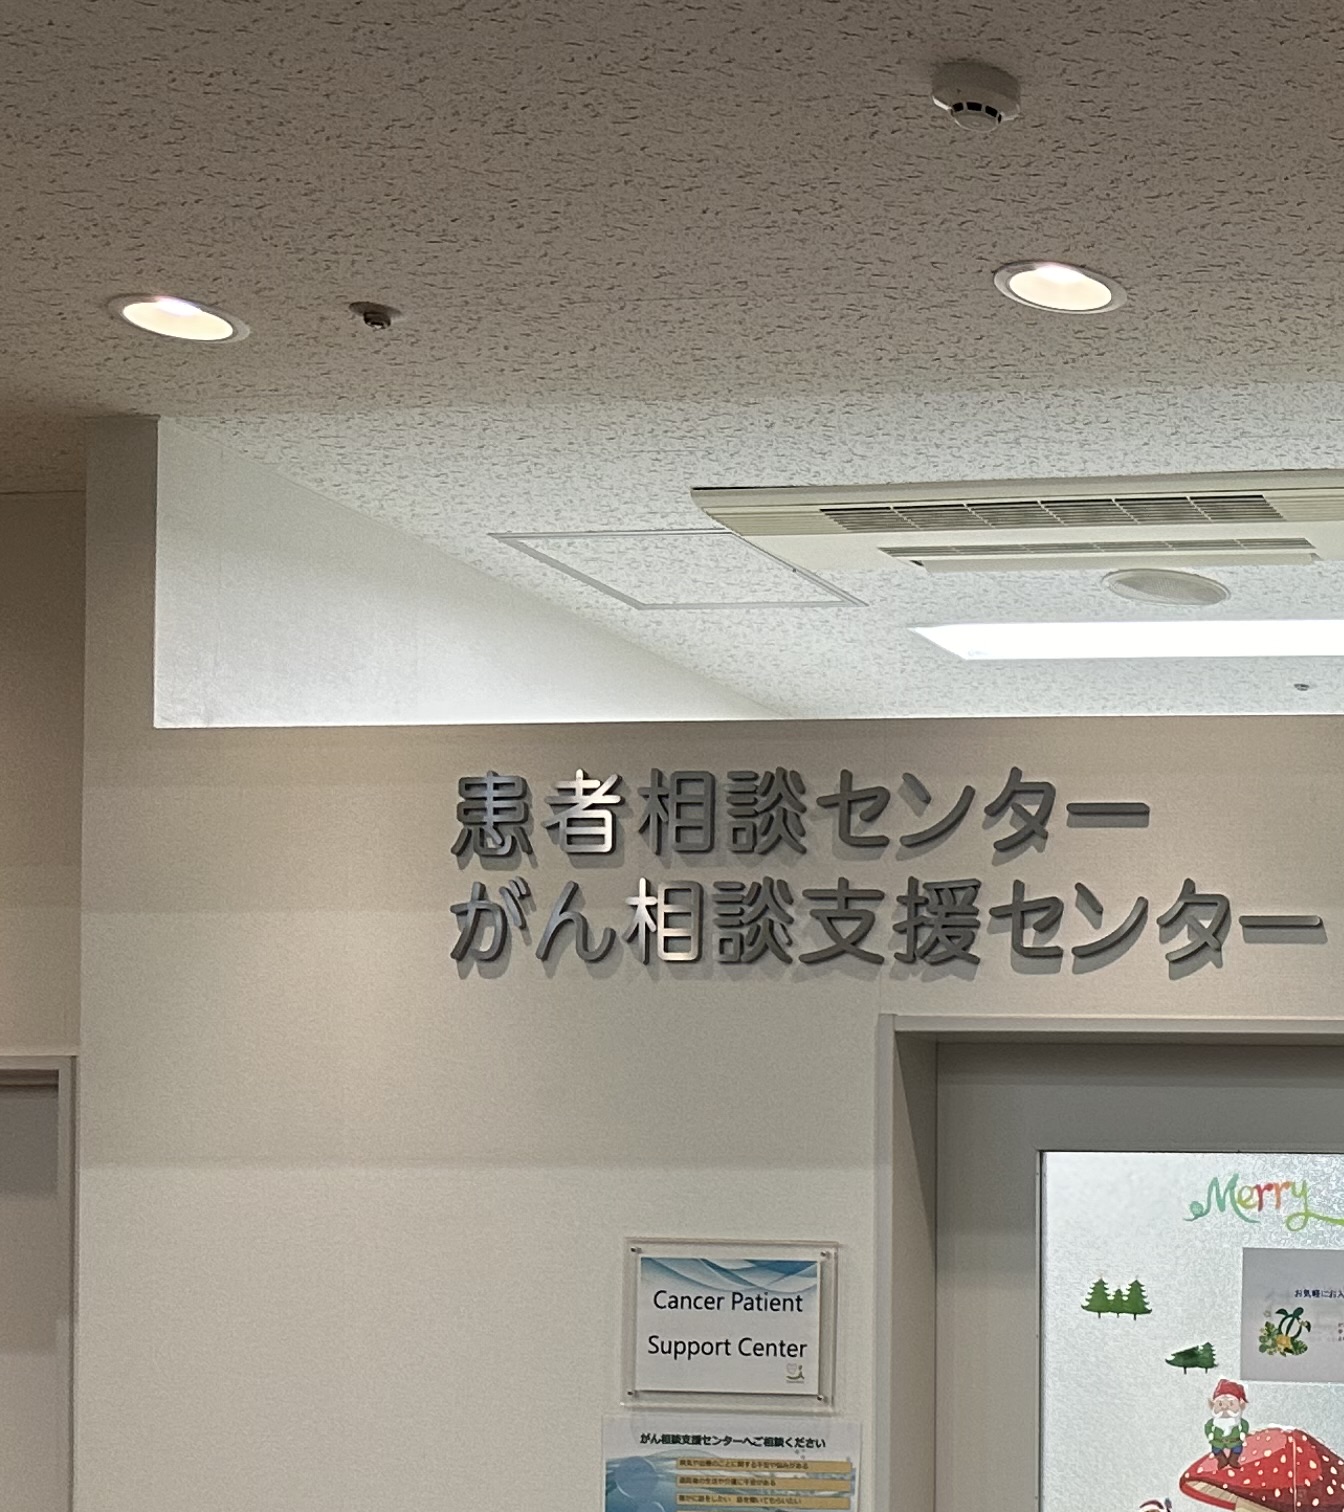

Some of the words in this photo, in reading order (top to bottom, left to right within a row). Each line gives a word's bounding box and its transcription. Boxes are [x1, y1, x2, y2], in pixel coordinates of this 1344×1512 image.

[450, 767, 1151, 861] 患者相談センター
[449, 873, 1328, 968] がん相談支援センター
[652, 1289, 725, 1311] Cancer
[731, 1291, 805, 1314] Patient
[647, 1334, 731, 1361] Support
[737, 1336, 809, 1359] Center
